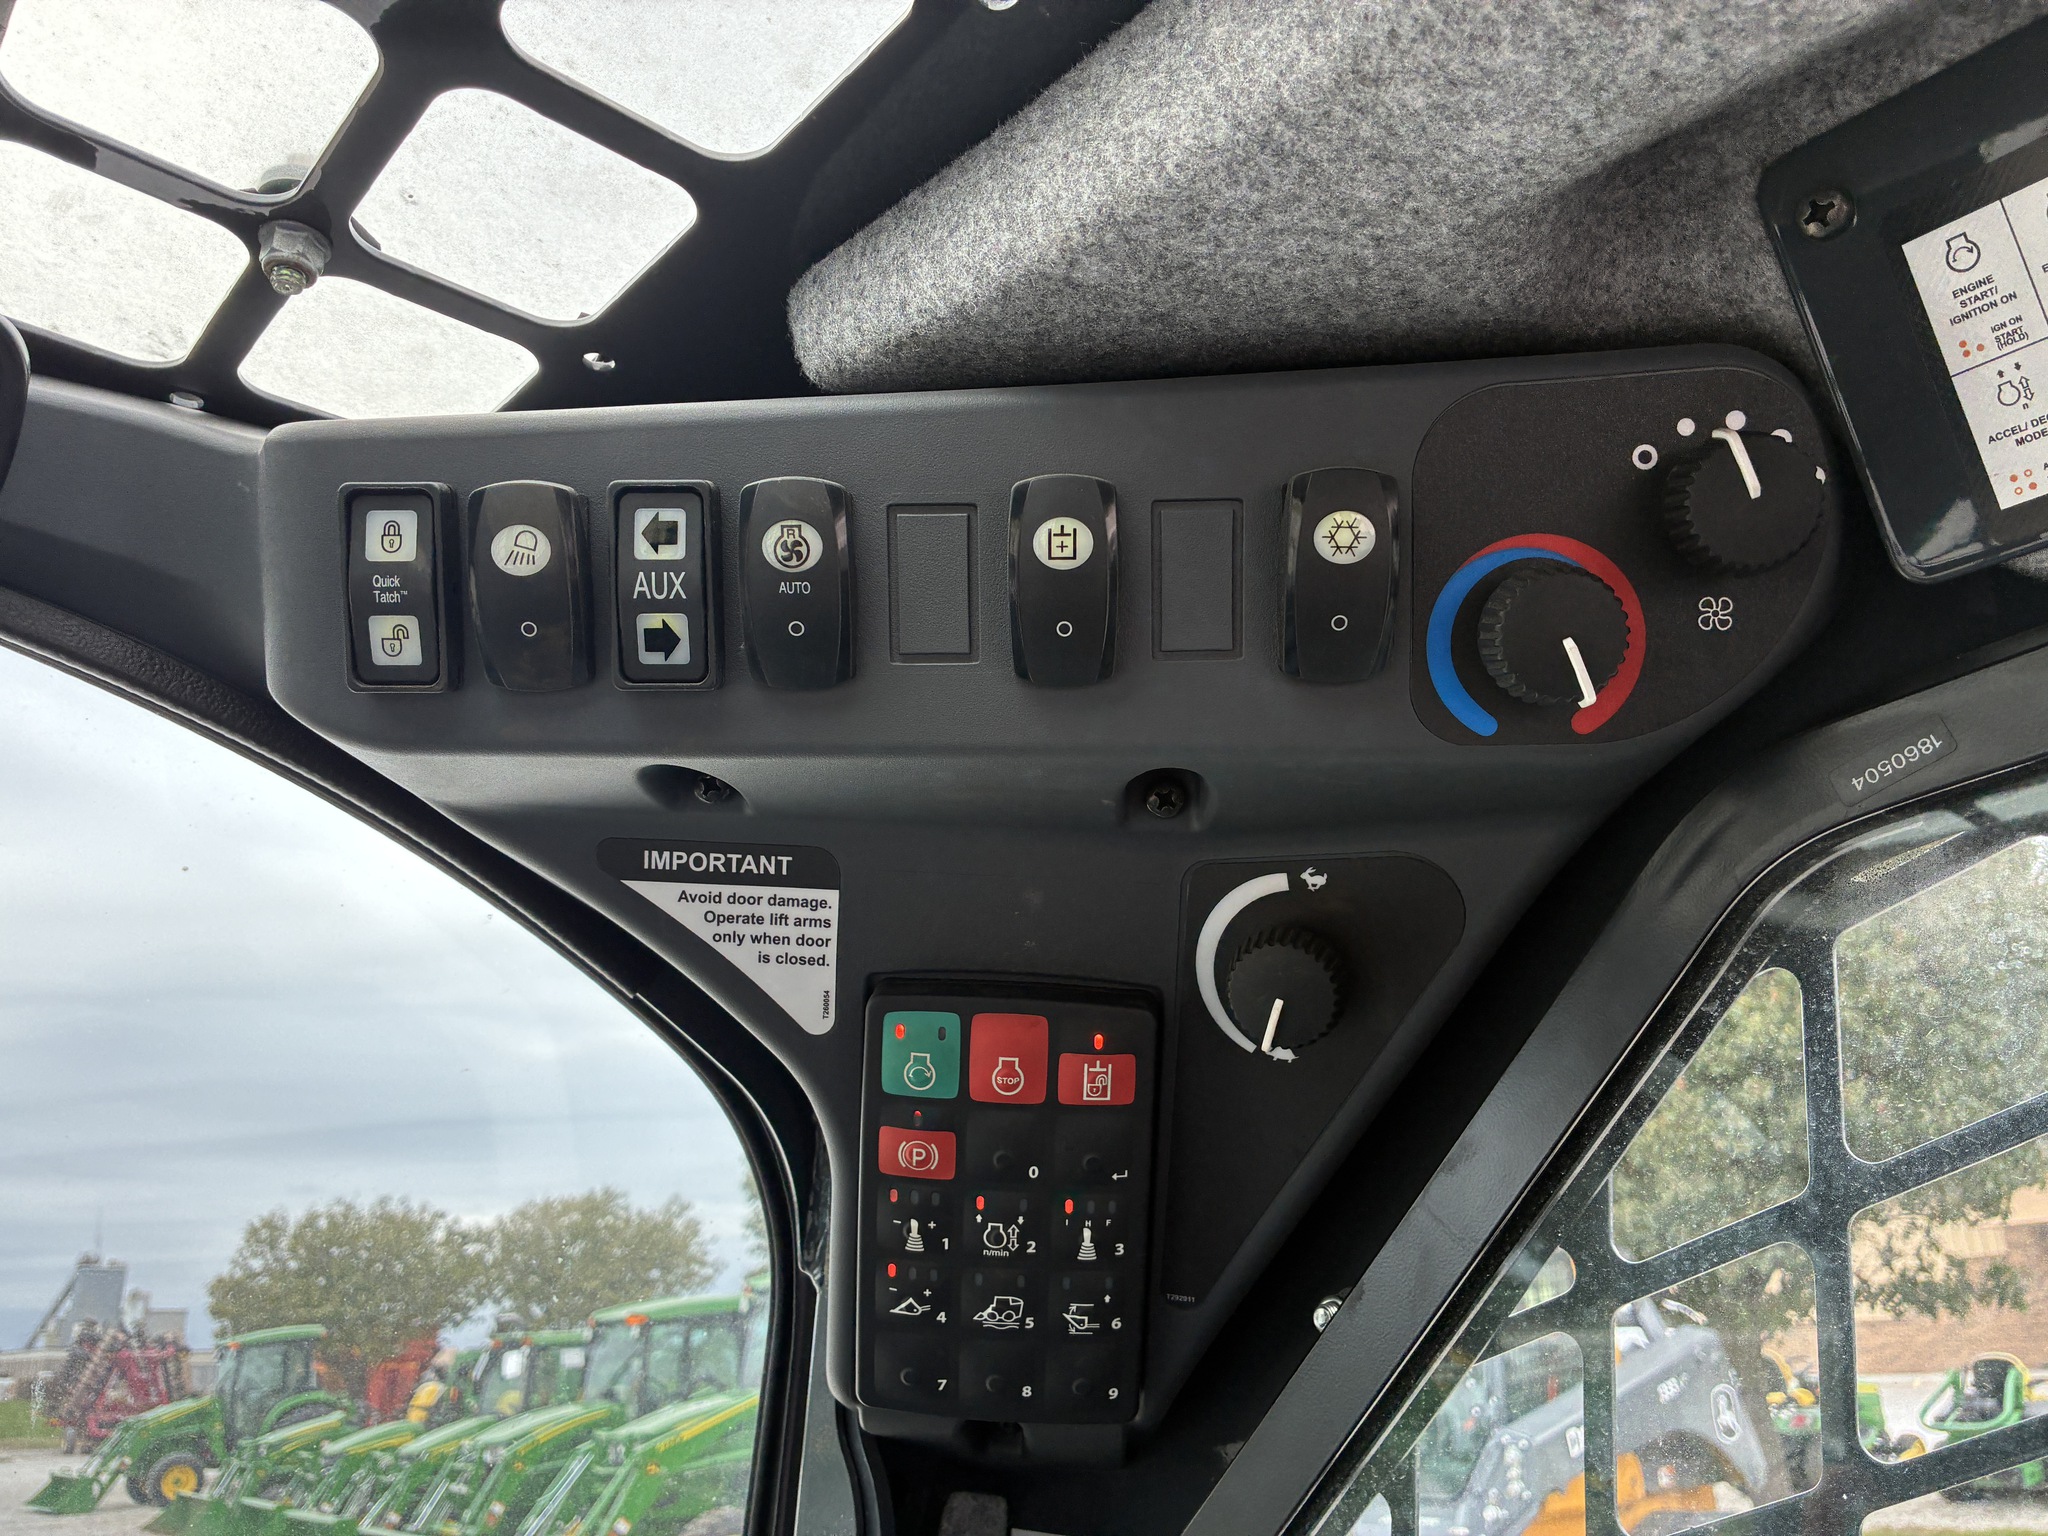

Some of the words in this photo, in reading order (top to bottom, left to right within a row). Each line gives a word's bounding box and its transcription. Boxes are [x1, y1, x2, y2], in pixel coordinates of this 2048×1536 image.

[1952, 274, 1995, 299] ENGINE
[1959, 285, 1998, 308] START/
[1949, 299, 1998, 326] IGNITION
[2000, 291, 2018, 304] ON
[1990, 321, 2007, 333] IGN
[2008, 314, 2023, 326] ON
[1994, 326, 2024, 343] START
[1997, 331, 2029, 351] (HOLD)
[1988, 421, 2028, 445] ACCEL/
[2031, 413, 2048, 428] DE
[2015, 428, 2048, 447] MODE
[787, 528, 796, 540] R
[372, 574, 401, 588] Quick
[633, 572, 687, 600] AUX
[779, 581, 811, 595] AUTO
[1851, 734, 1943, 791] 1860504
[643, 850, 793, 876] IMPORTANT
[677, 890, 722, 904] Avoid
[726, 892, 763, 906] door
[767, 893, 832, 911] damage.
[703, 910, 765, 926] Operate
[769, 913, 789, 927] lift
[793, 916, 832, 928] arms
[712, 930, 746, 947] only
[750, 932, 791, 946] when
[795, 934, 832, 948] door
[758, 951, 771, 964] is
[775, 952, 830, 967] closed.
[996, 1077, 1020, 1085] STOP
[911, 1148, 926, 1166] P
[1028, 1165, 1039, 1179] 0
[1106, 1219, 1112, 1227] F
[941, 1238, 949, 1250] 1
[1026, 1241, 1036, 1253] 2
[1114, 1243, 1124, 1255] 3
[983, 1249, 1010, 1258] n/min
[936, 1311, 947, 1323] 4
[1025, 1317, 1034, 1329] 5
[1111, 1318, 1121, 1330] 6
[937, 1379, 947, 1391] 7
[1021, 1386, 1032, 1398] 8
[1108, 1387, 1119, 1400] 9
